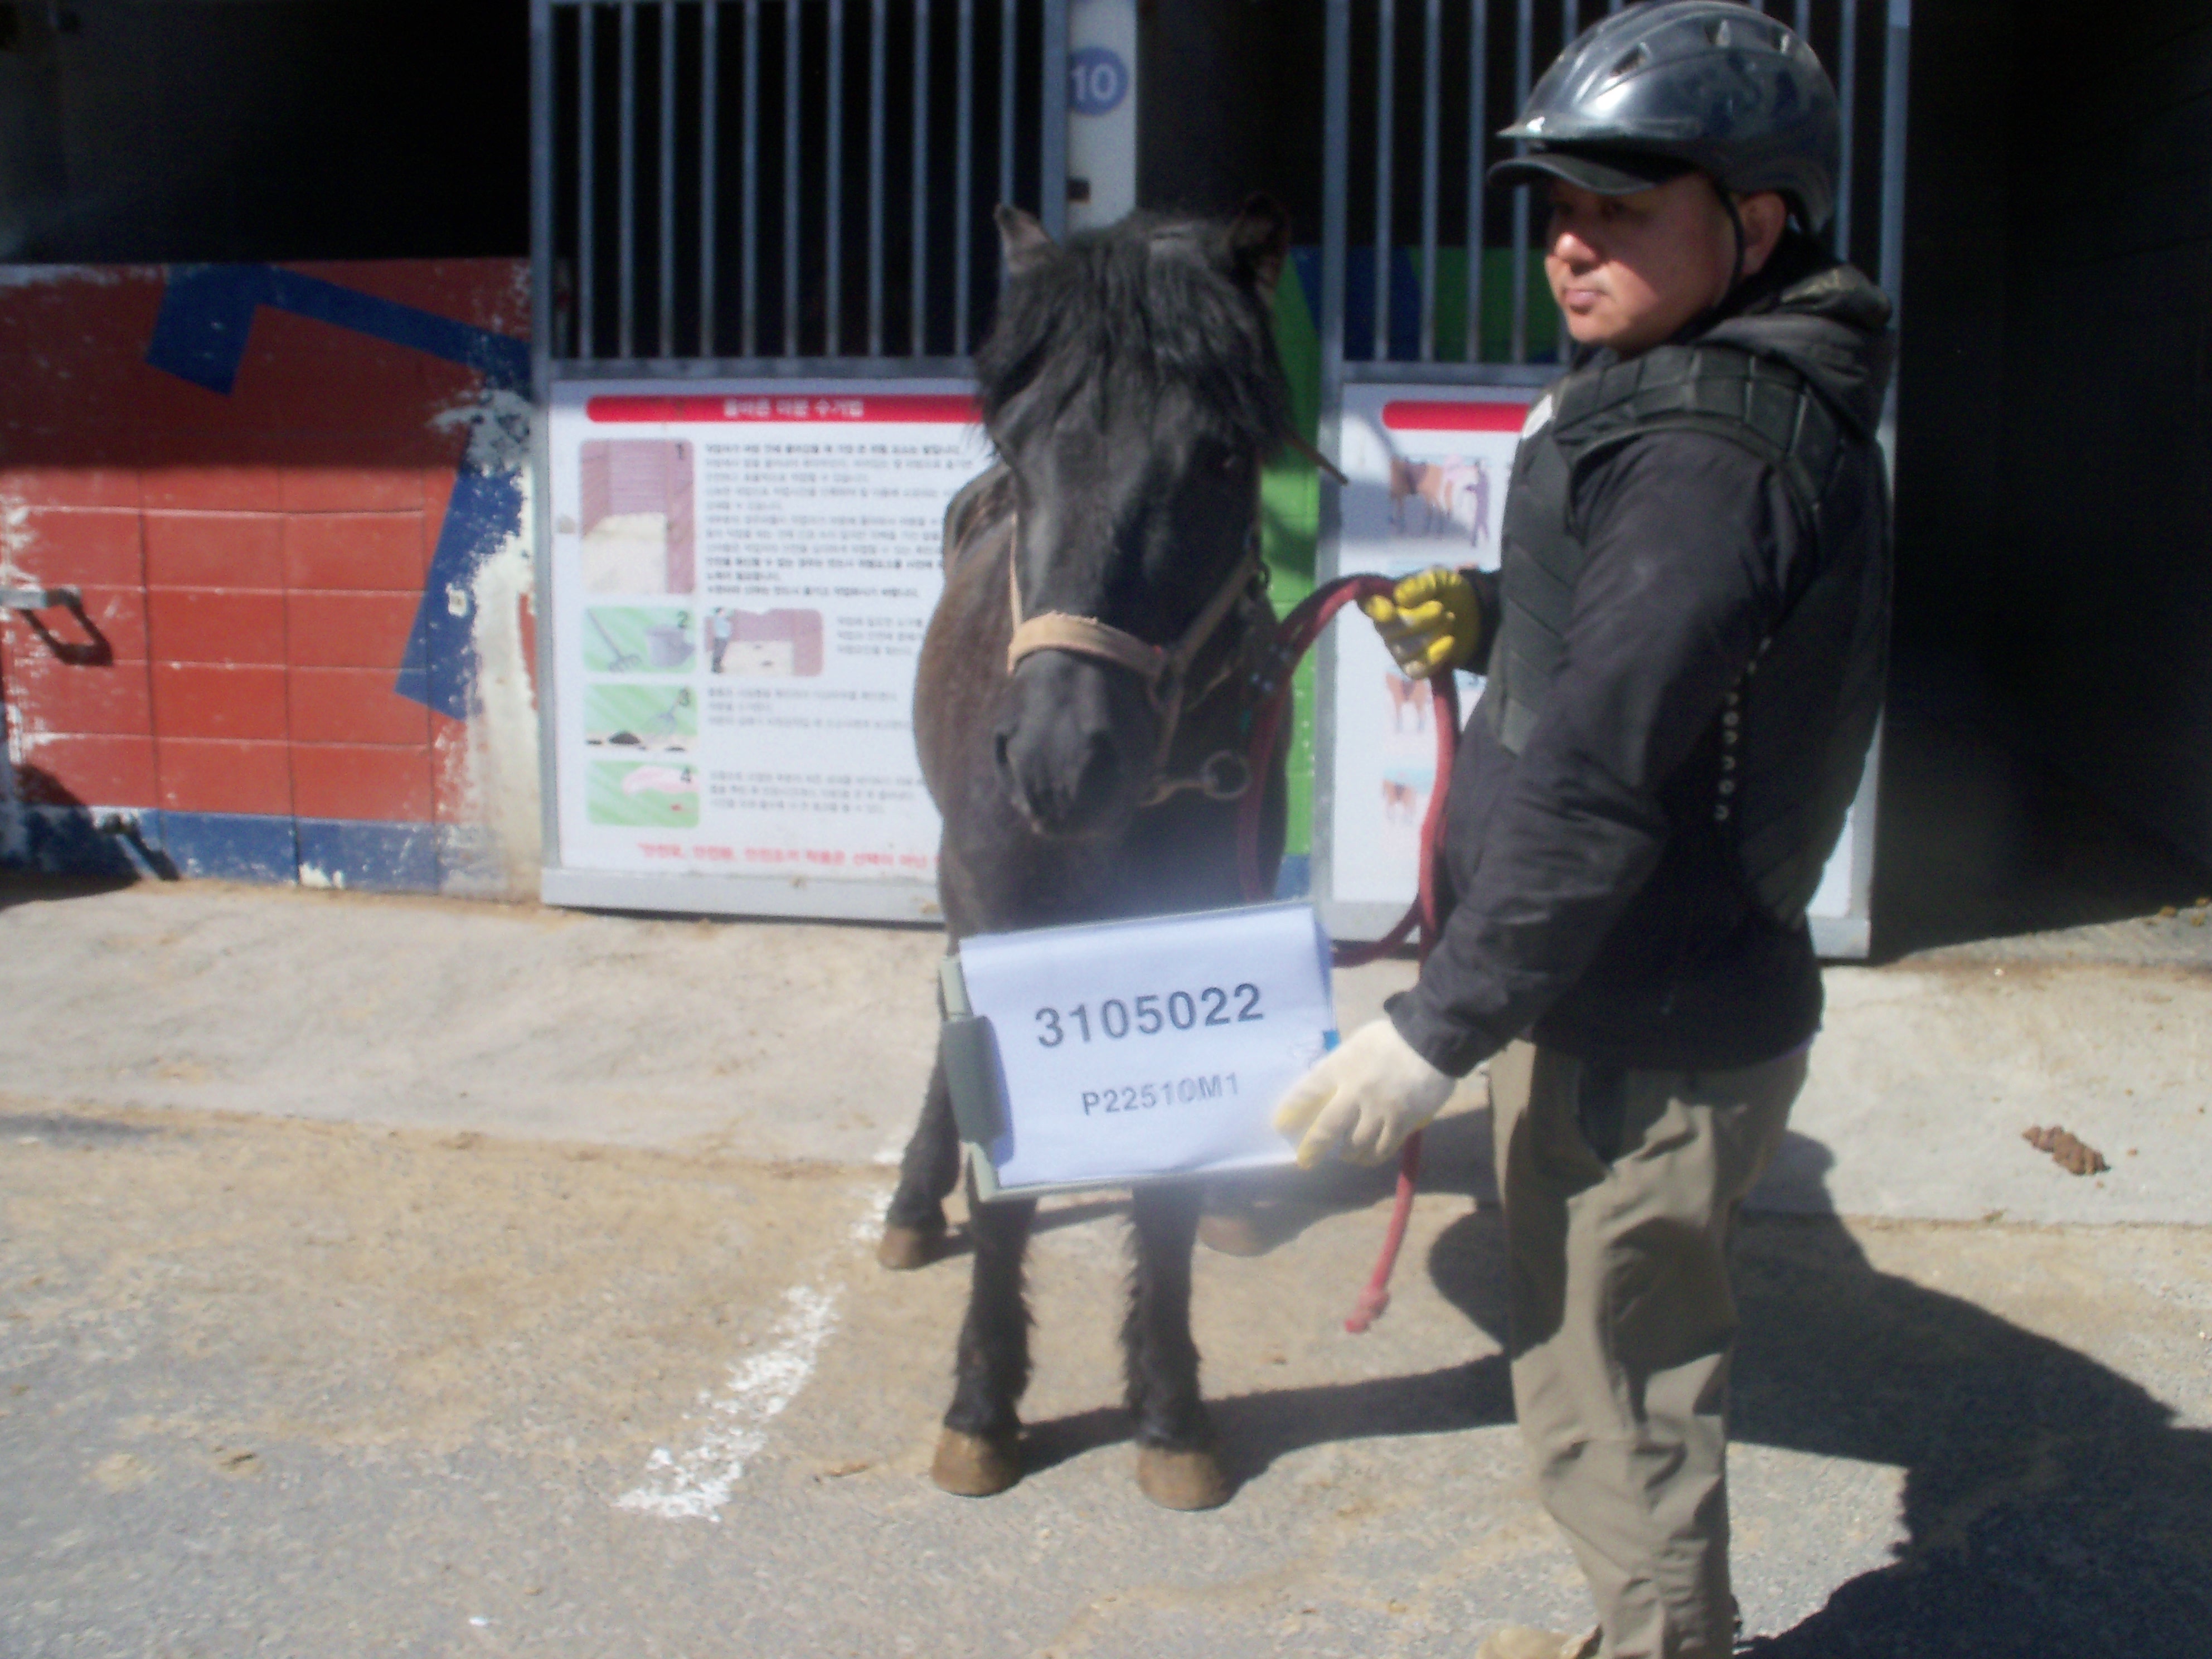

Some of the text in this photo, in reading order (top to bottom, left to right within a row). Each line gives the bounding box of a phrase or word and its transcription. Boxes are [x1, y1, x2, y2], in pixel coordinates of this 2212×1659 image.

[1071, 63, 1117, 103] 10
[677, 610, 688, 629] 2
[1035, 982, 1264, 1047] 3105022
